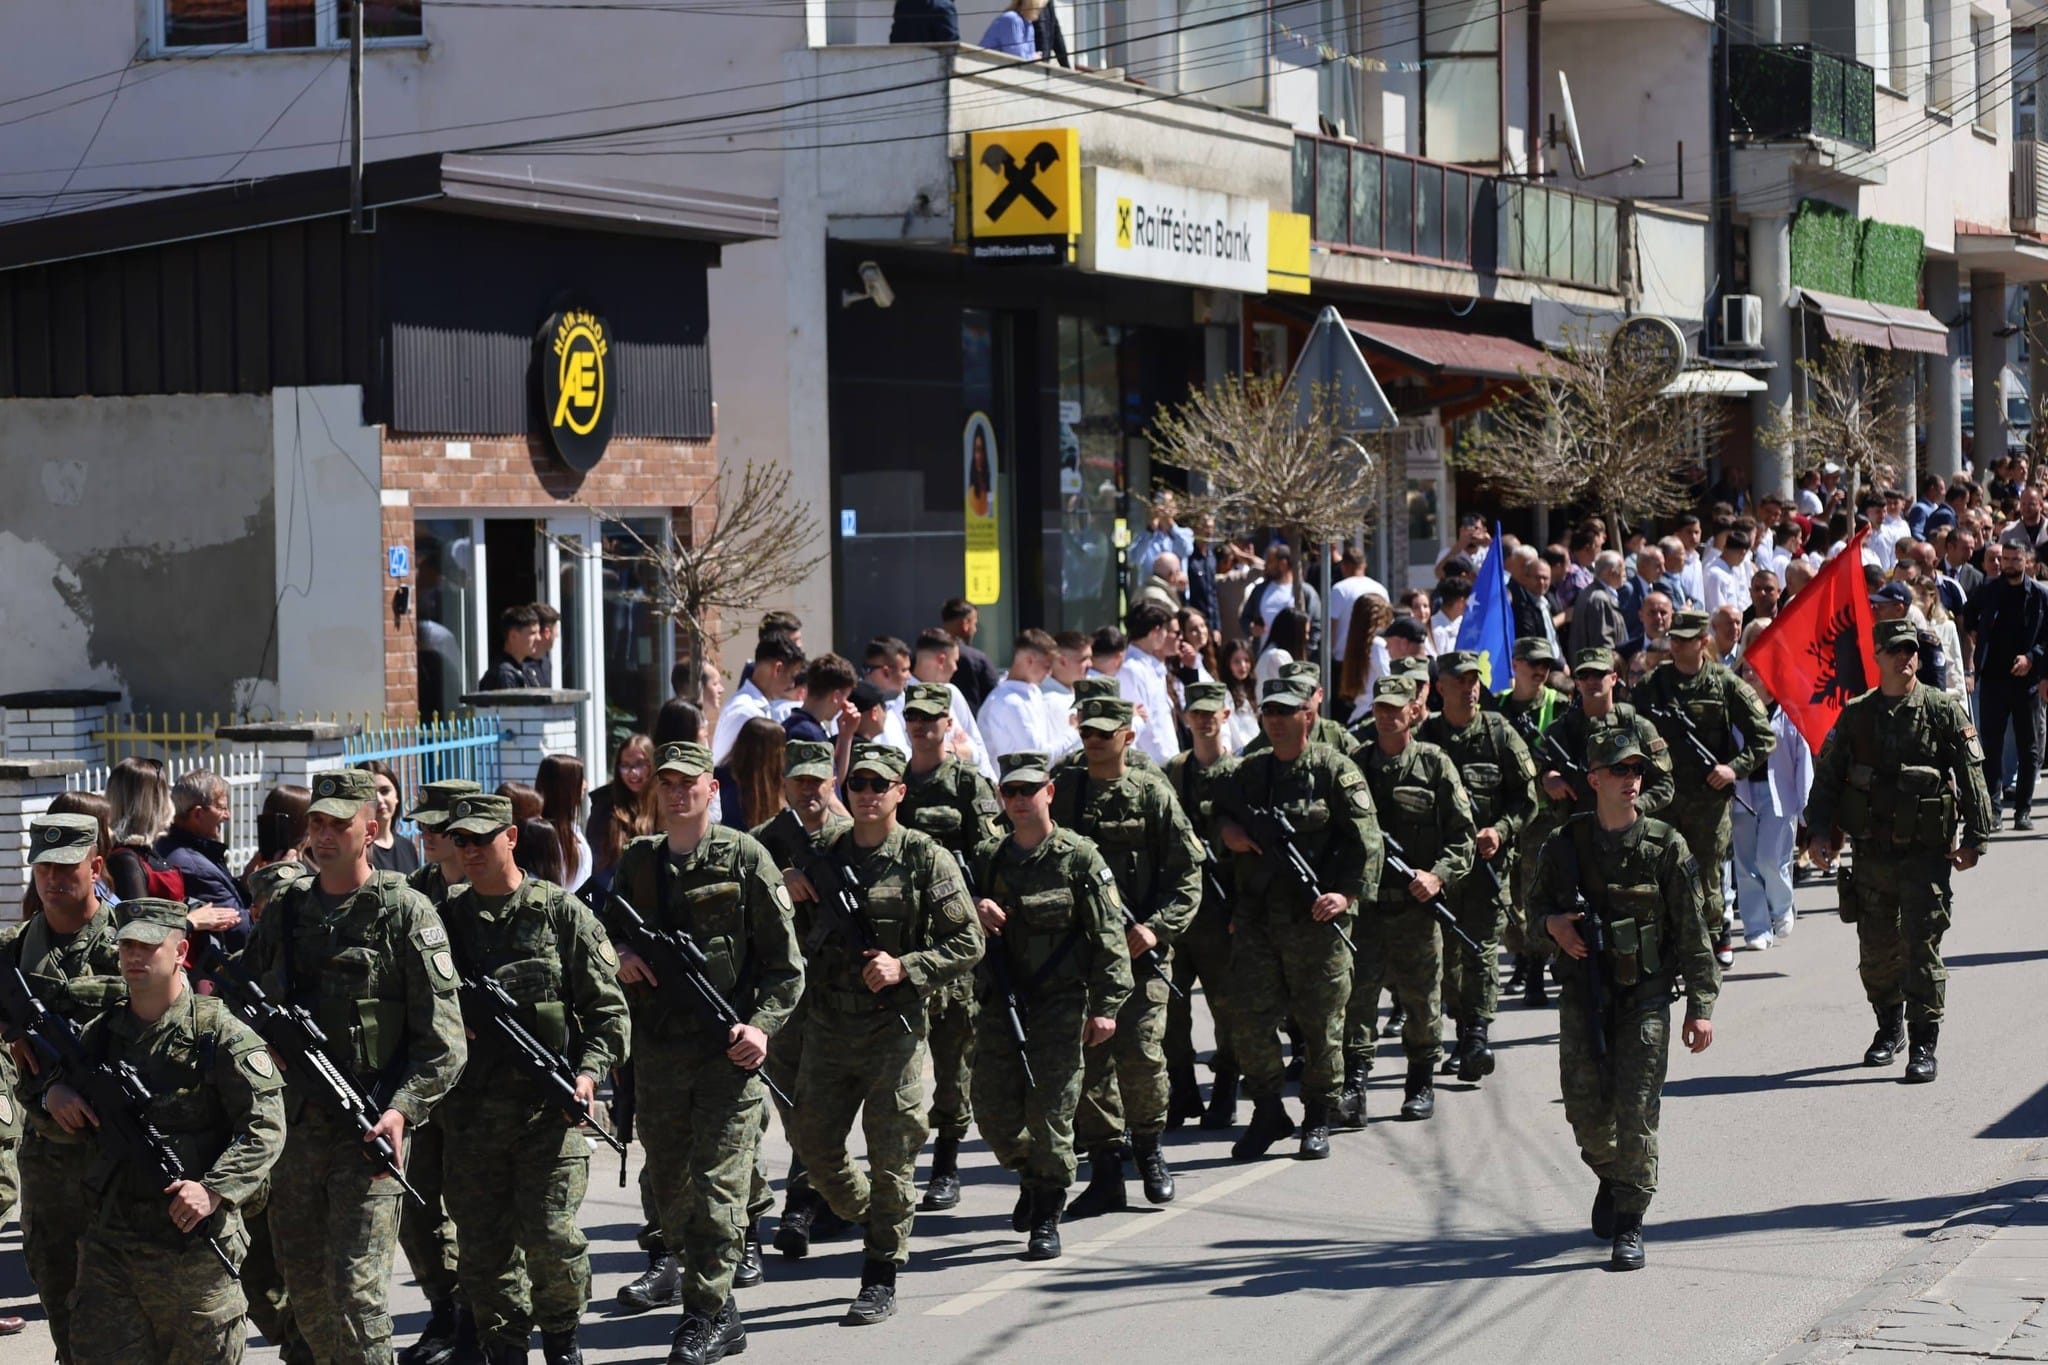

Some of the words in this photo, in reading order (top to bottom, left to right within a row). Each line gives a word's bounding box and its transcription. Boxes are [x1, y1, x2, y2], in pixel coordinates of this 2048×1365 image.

[1135, 205, 1213, 255] Raiffeisen
[1215, 218, 1251, 263] Bank
[974, 244, 1027, 257] Raiffeisen
[1028, 242, 1055, 256] Bank
[553, 311, 576, 356] HAIR
[577, 307, 608, 356] SALON
[390, 548, 409, 575] 42
[422, 929, 445, 942] EOD
